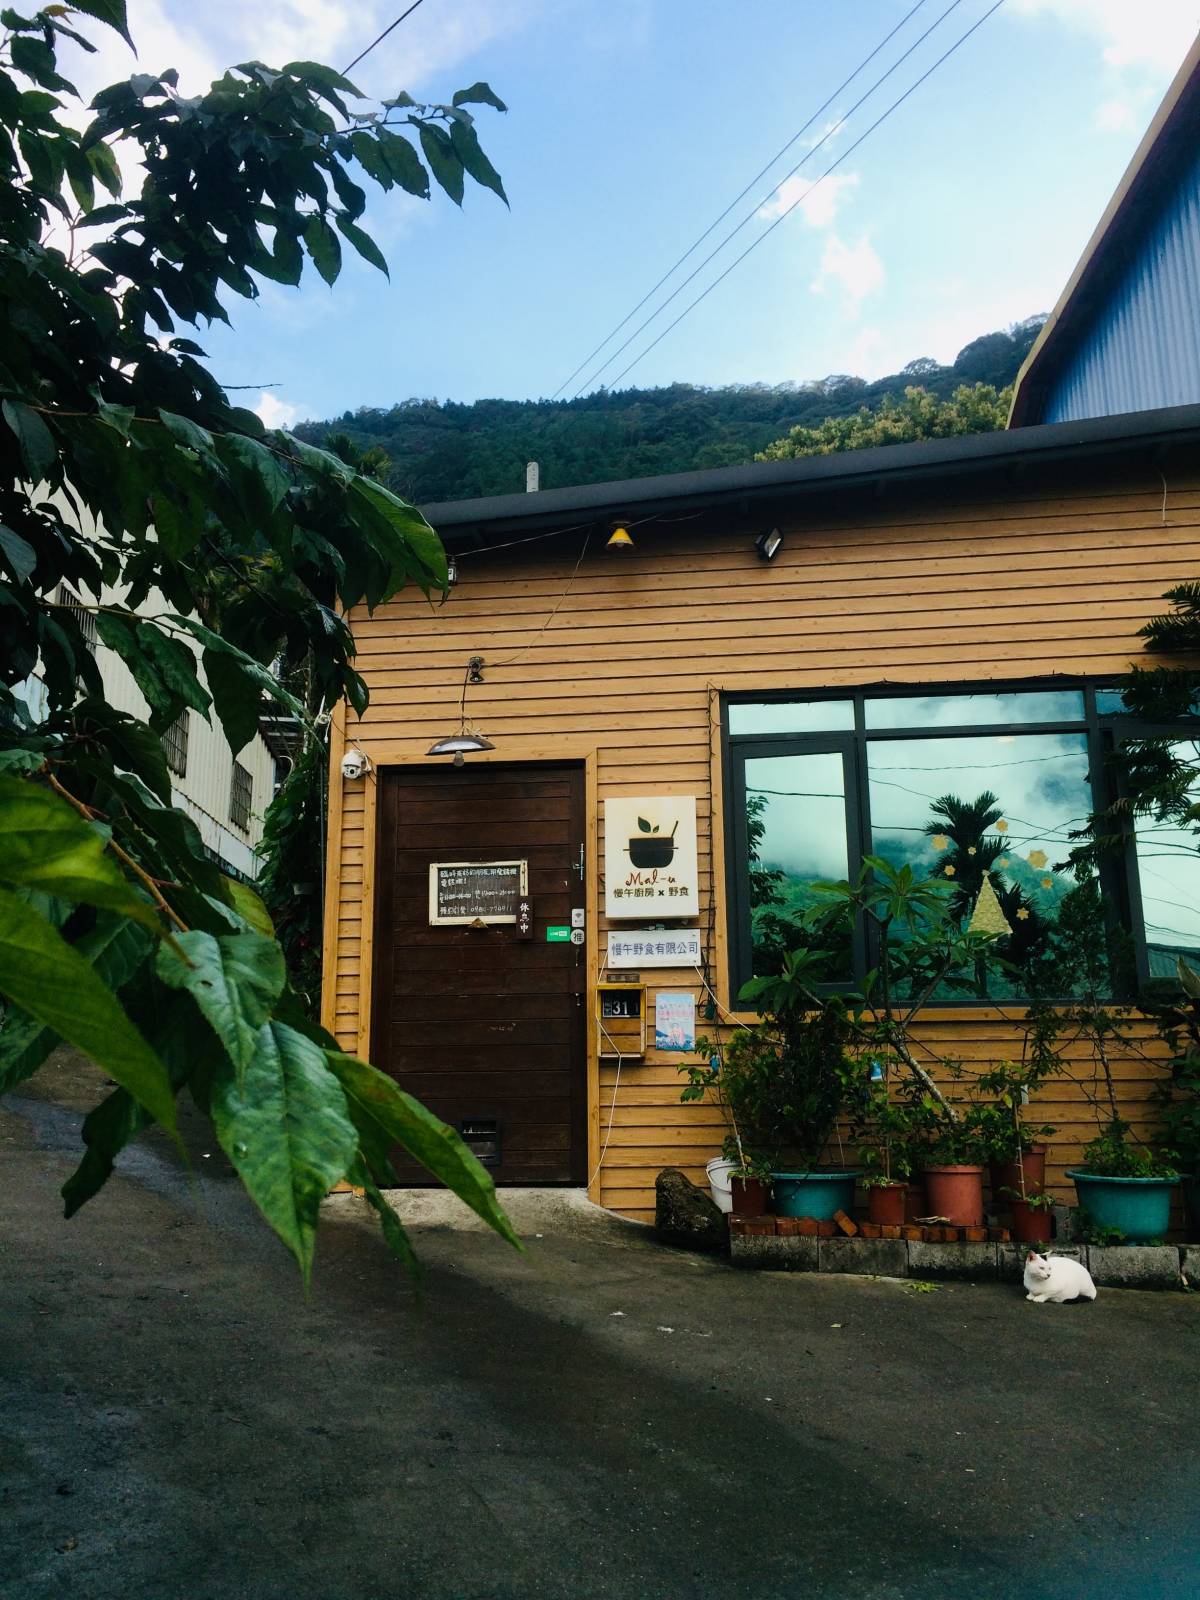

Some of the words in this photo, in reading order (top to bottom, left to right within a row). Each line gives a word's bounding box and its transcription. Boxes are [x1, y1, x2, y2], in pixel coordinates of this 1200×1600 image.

[613, 887, 655, 899] 慢午廚房
[668, 886, 689, 897] 野食
[519, 902, 530, 933] 休息中
[573, 931, 584, 942] 推
[611, 941, 698, 956] 慢午野食有限公司
